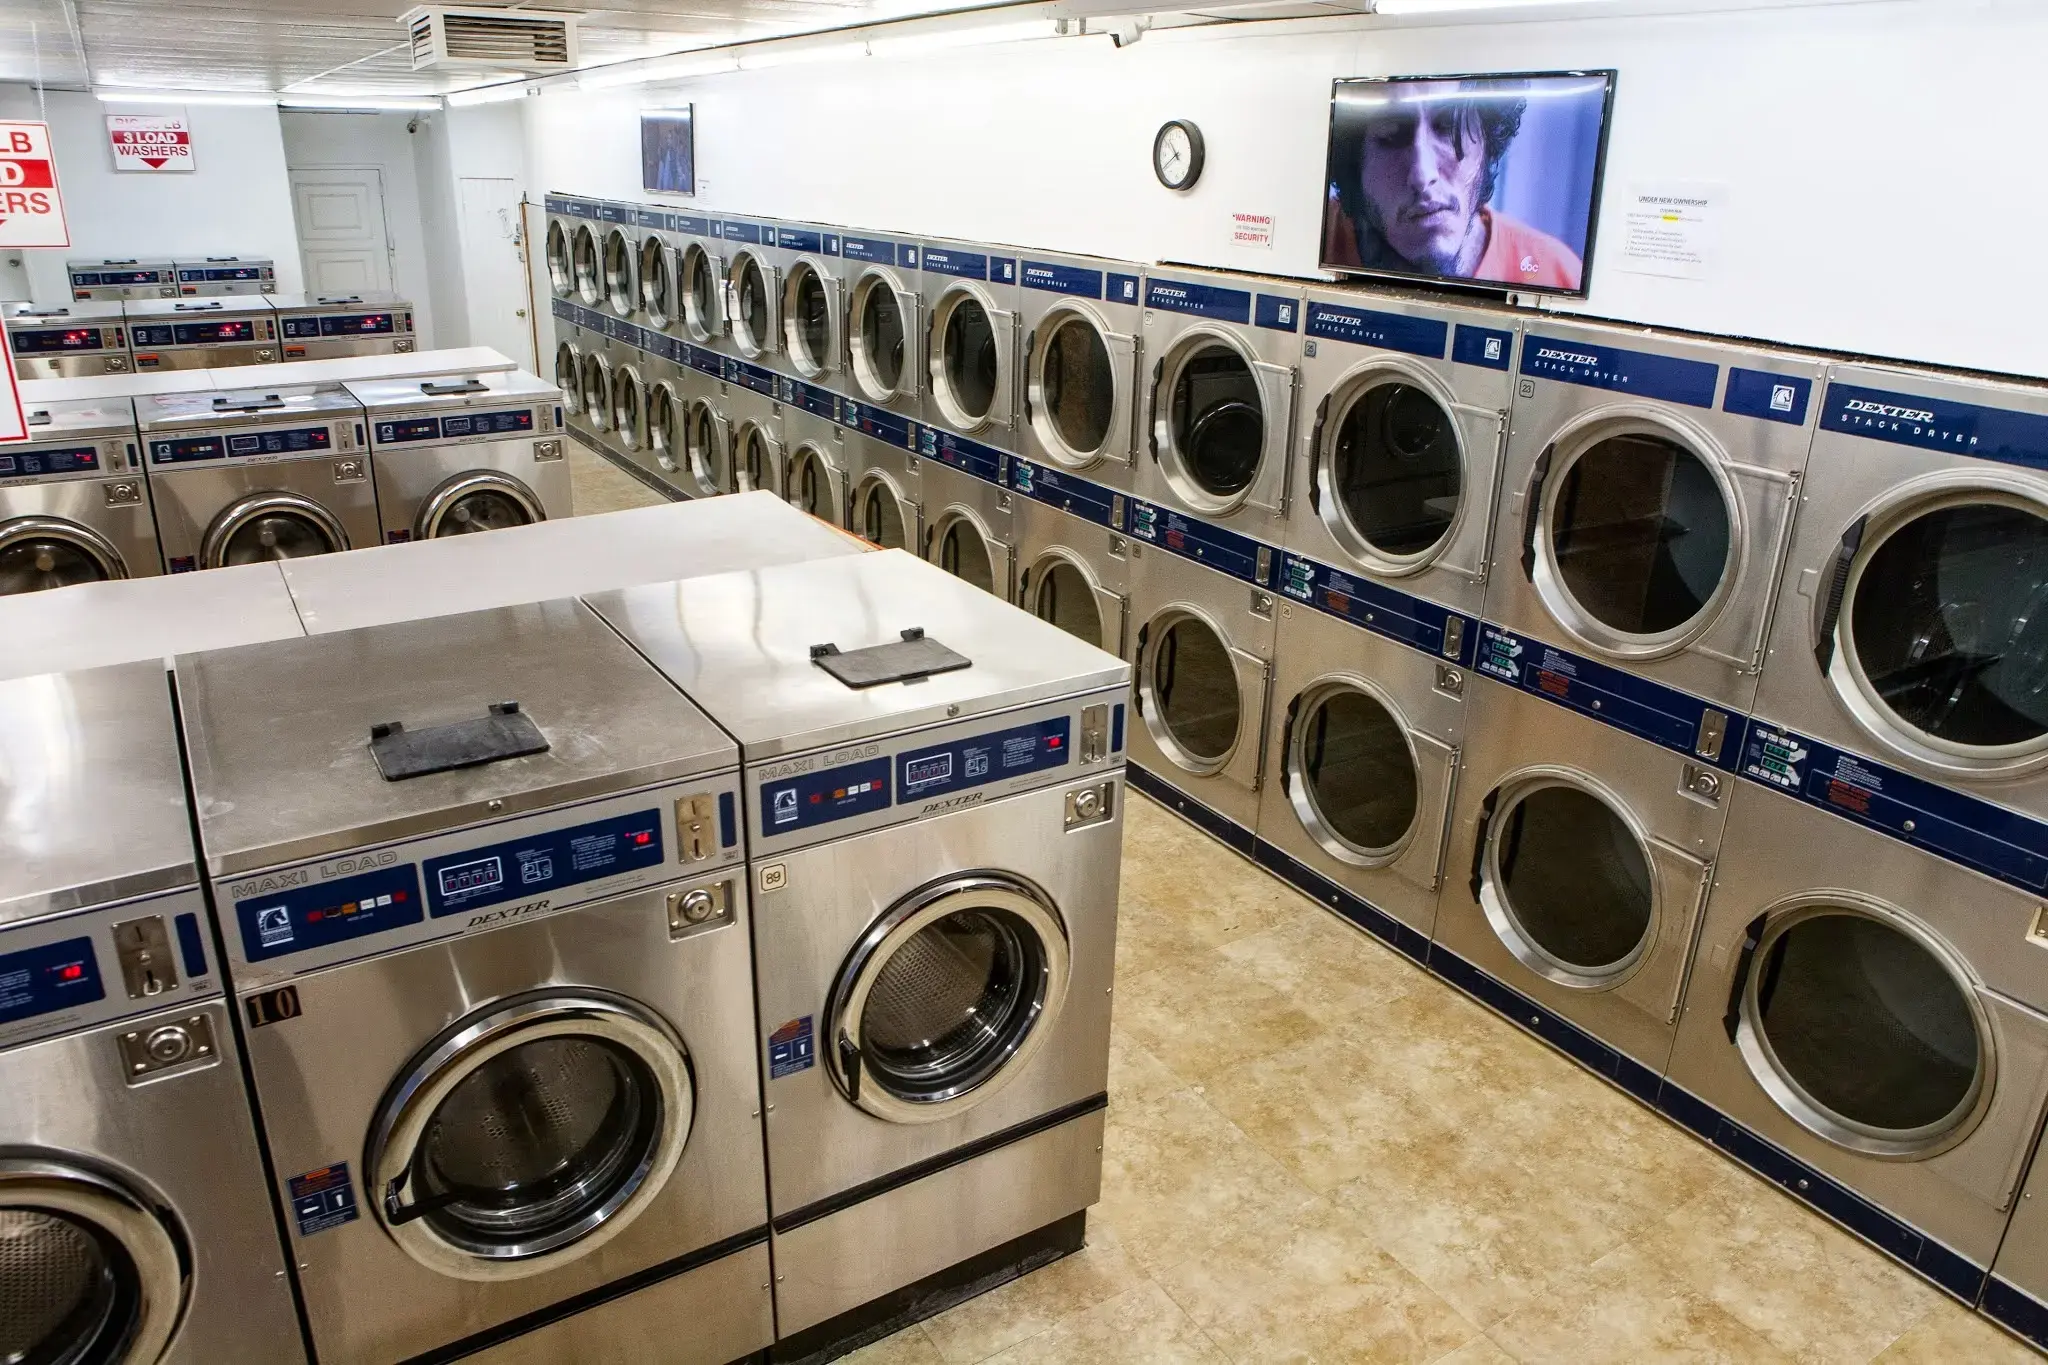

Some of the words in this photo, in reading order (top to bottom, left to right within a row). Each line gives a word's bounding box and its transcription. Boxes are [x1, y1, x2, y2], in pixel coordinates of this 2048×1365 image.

[123, 131, 134, 144] 3
[136, 131, 178, 144] LOAD
[117, 145, 189, 156] WASHERS
[1638, 195, 1659, 204] UNDER
[1659, 197, 1673, 205] NEW
[1674, 198, 1708, 207] OWNERSHIP
[1234, 213, 1271, 225] WARNING
[1234, 231, 1269, 243] SECURITY
[926, 253, 949, 263] DEXTER
[1026, 268, 1054, 278] DEXTER
[1026, 276, 1045, 284] STACK
[1047, 280, 1068, 288] DRYER
[1152, 287, 1188, 298] DEXTER
[1151, 296, 1175, 305] STACK
[1179, 300, 1204, 309] DRYER
[1316, 312, 1362, 326] DEXTER
[1314, 323, 1345, 333] STACK
[1351, 329, 1385, 340] DRYER
[1536, 348, 1598, 367] DEXTER
[1534, 360, 1575, 374] STACK
[1584, 369, 1629, 383] DRYER
[1521, 383, 1532, 394] 23
[1844, 399, 1934, 423] DEXTER
[1841, 413, 1899, 431] STACK
[1913, 426, 1978, 446] DRYER
[759, 759, 814, 781] MAXI
[824, 744, 879, 767] LOAD
[920, 792, 983, 814] DEXTER
[232, 870, 308, 898] MAXI
[321, 850, 398, 879] LOAD
[765, 870, 781, 886] 89
[467, 899, 551, 928] DEXTER
[250, 989, 295, 1026] 10
